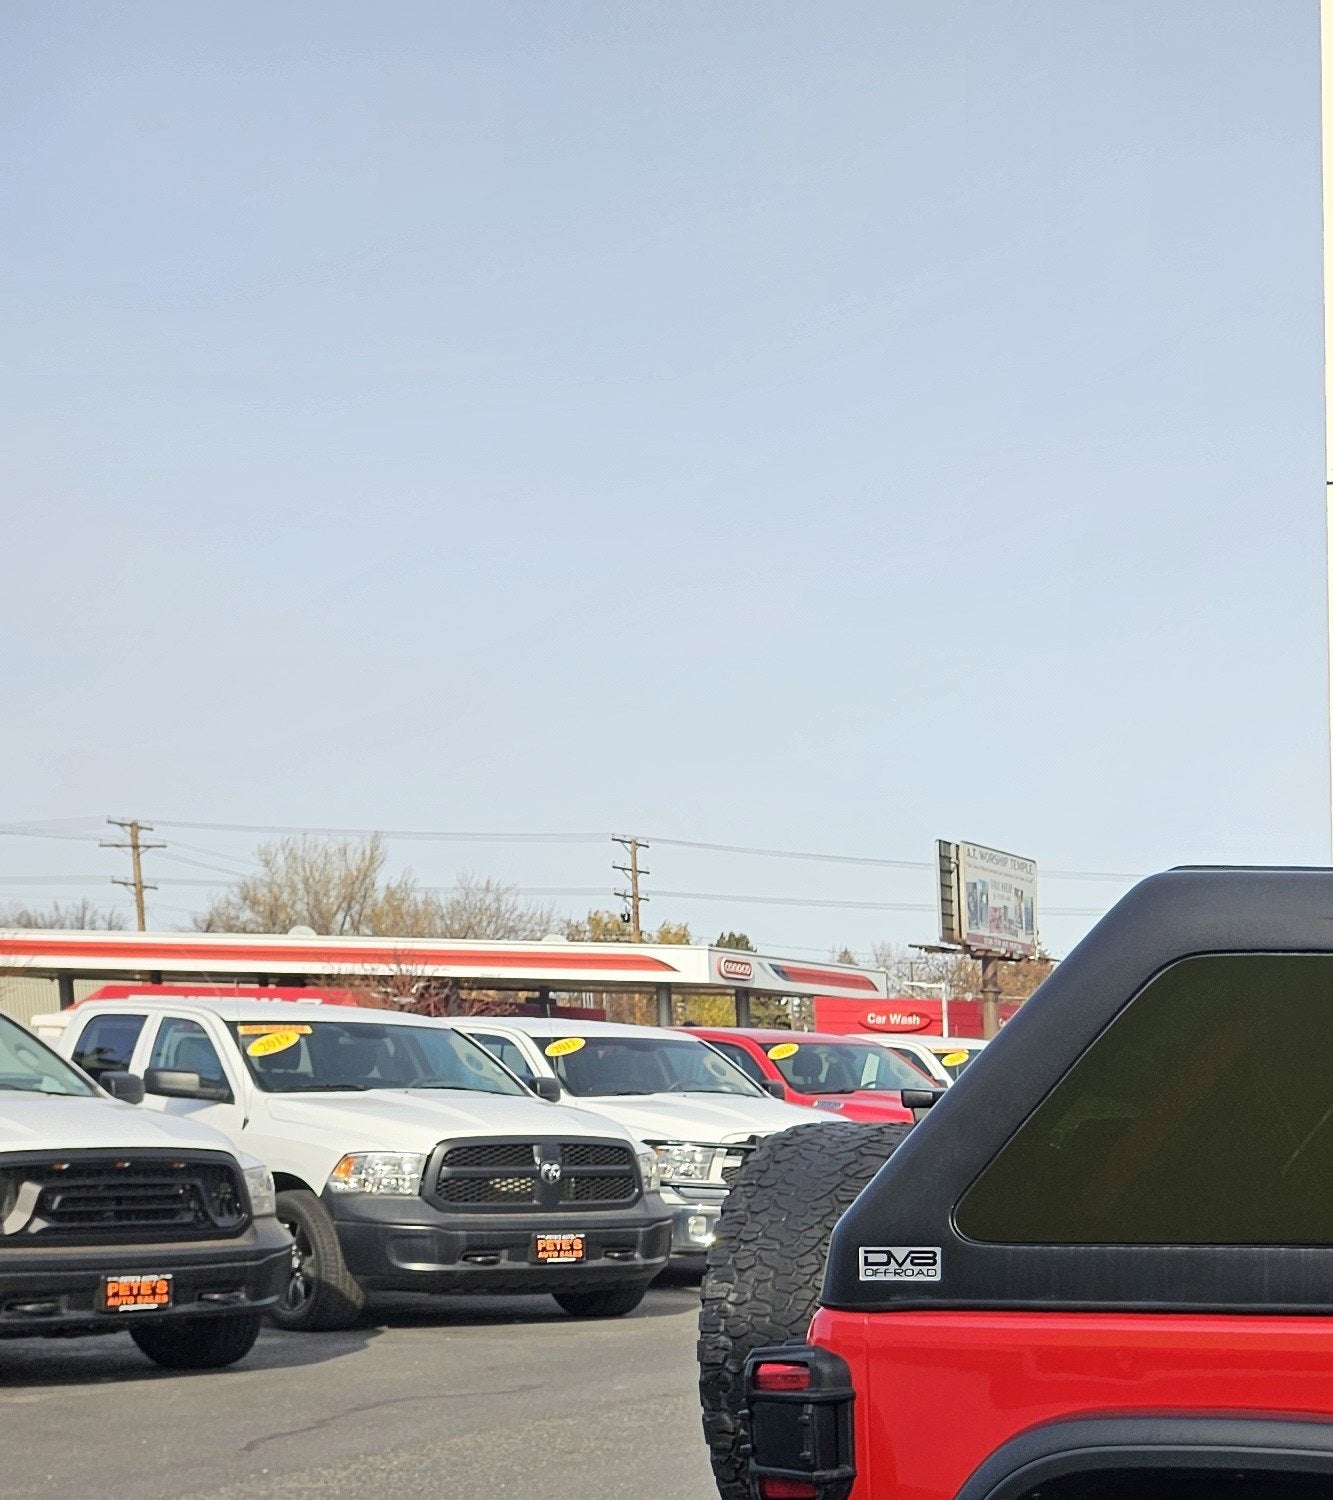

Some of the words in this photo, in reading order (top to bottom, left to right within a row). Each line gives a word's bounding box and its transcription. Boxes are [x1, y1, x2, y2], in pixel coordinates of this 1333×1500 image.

[1010, 859, 1034, 874] TEMPLE
[867, 1013, 886, 1024] Car
[889, 1013, 921, 1025] Wash
[537, 1238, 583, 1251] PETE'S
[107, 1280, 169, 1297] PETE'S
